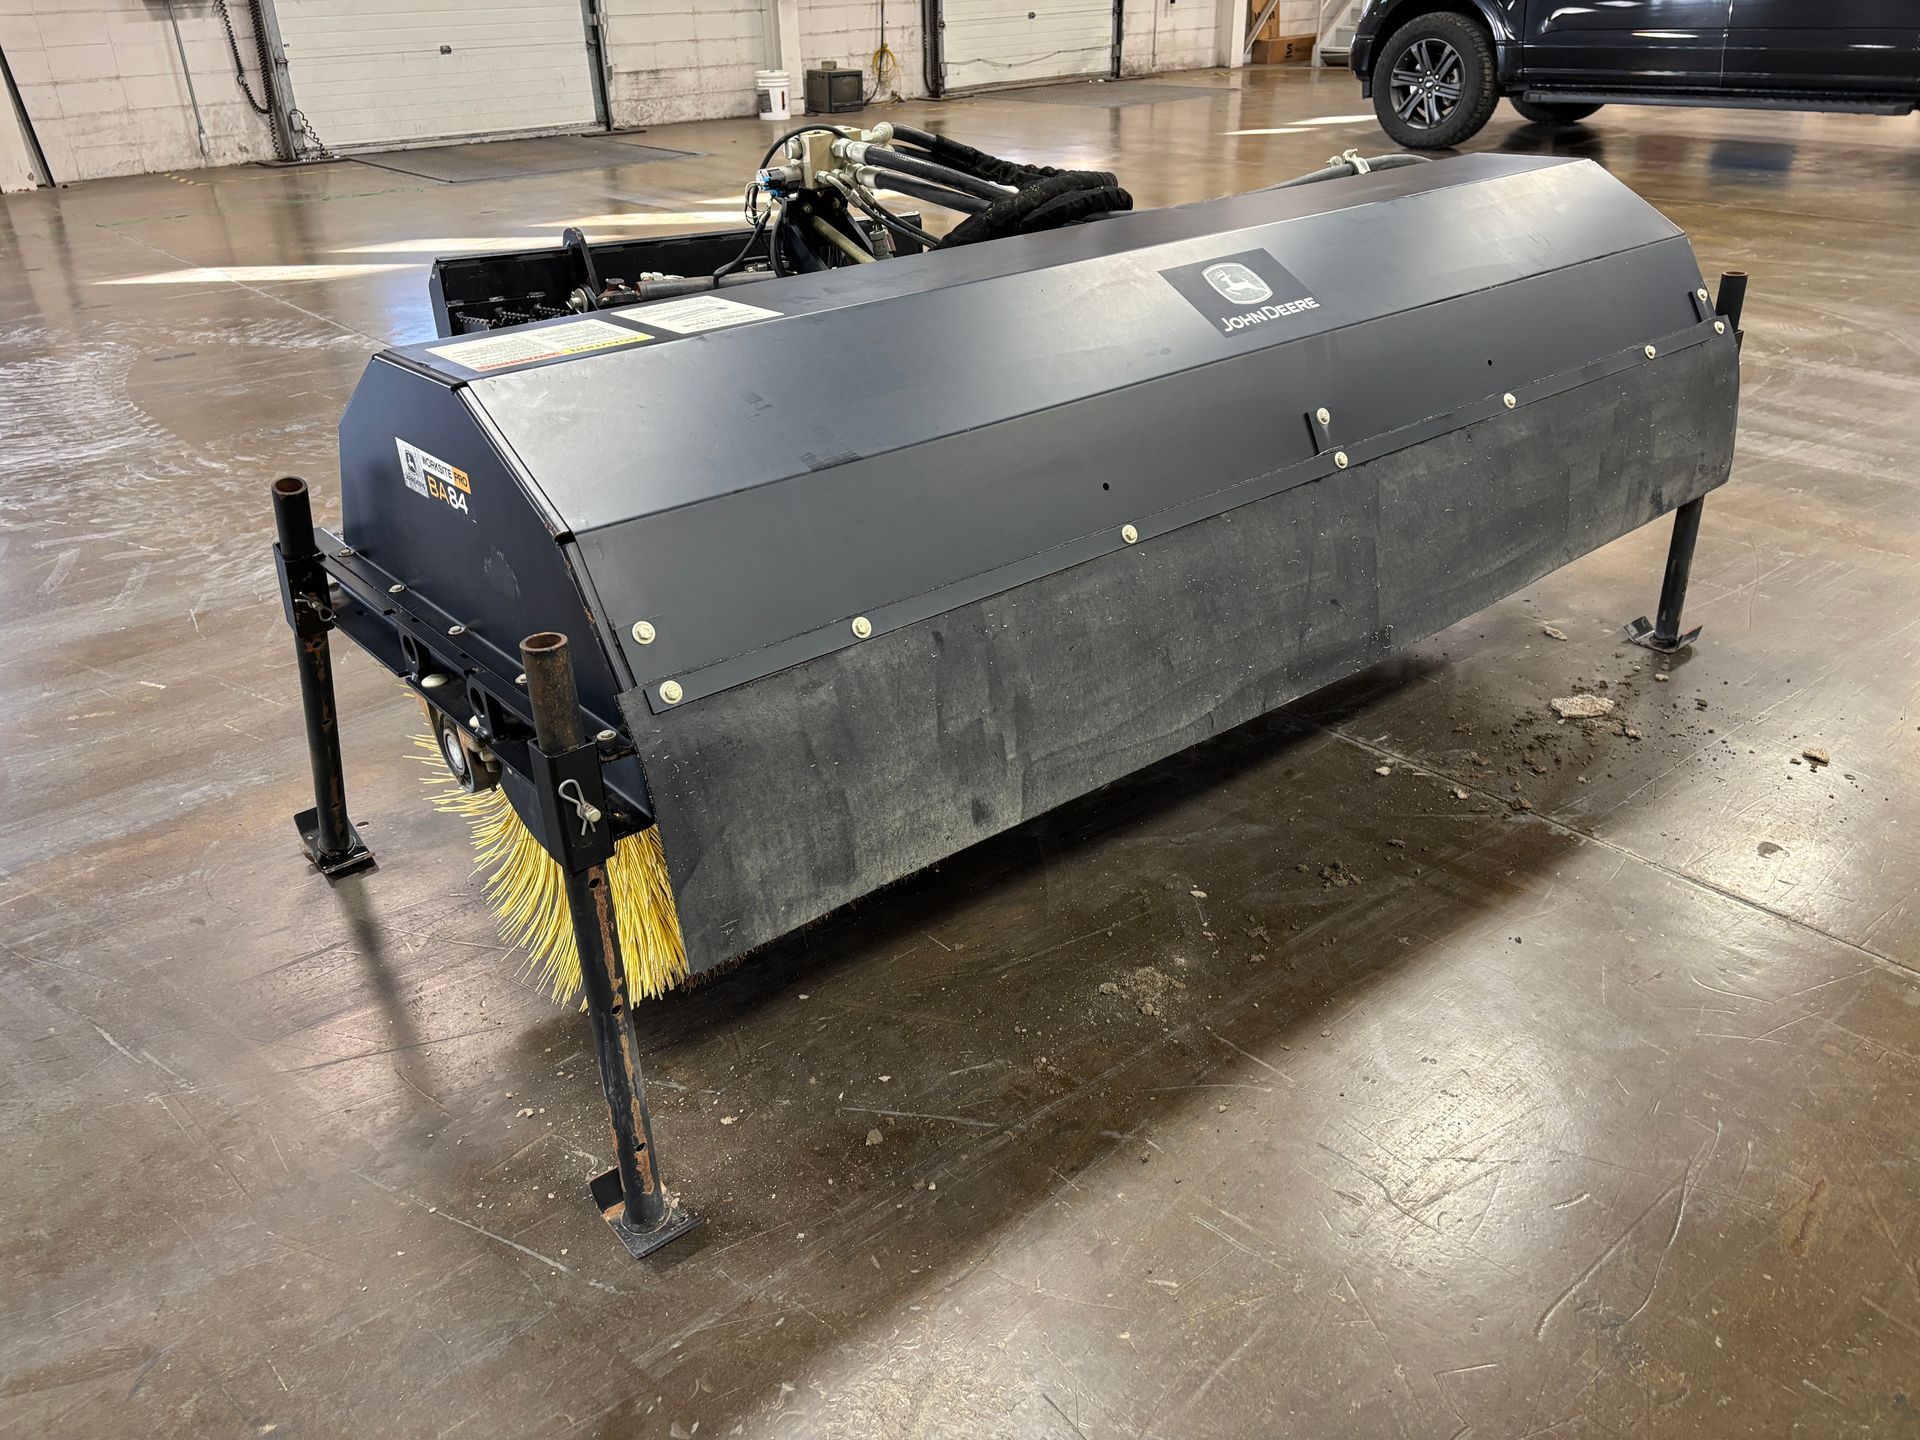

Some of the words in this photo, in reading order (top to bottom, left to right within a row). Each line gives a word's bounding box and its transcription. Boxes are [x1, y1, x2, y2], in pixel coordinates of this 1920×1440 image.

[1220, 309, 1267, 332] JOHN
[1260, 296, 1321, 319] DEERE
[421, 454, 453, 480] WORKSITE
[453, 471, 468, 488] PRO
[427, 474, 469, 515] BA84
